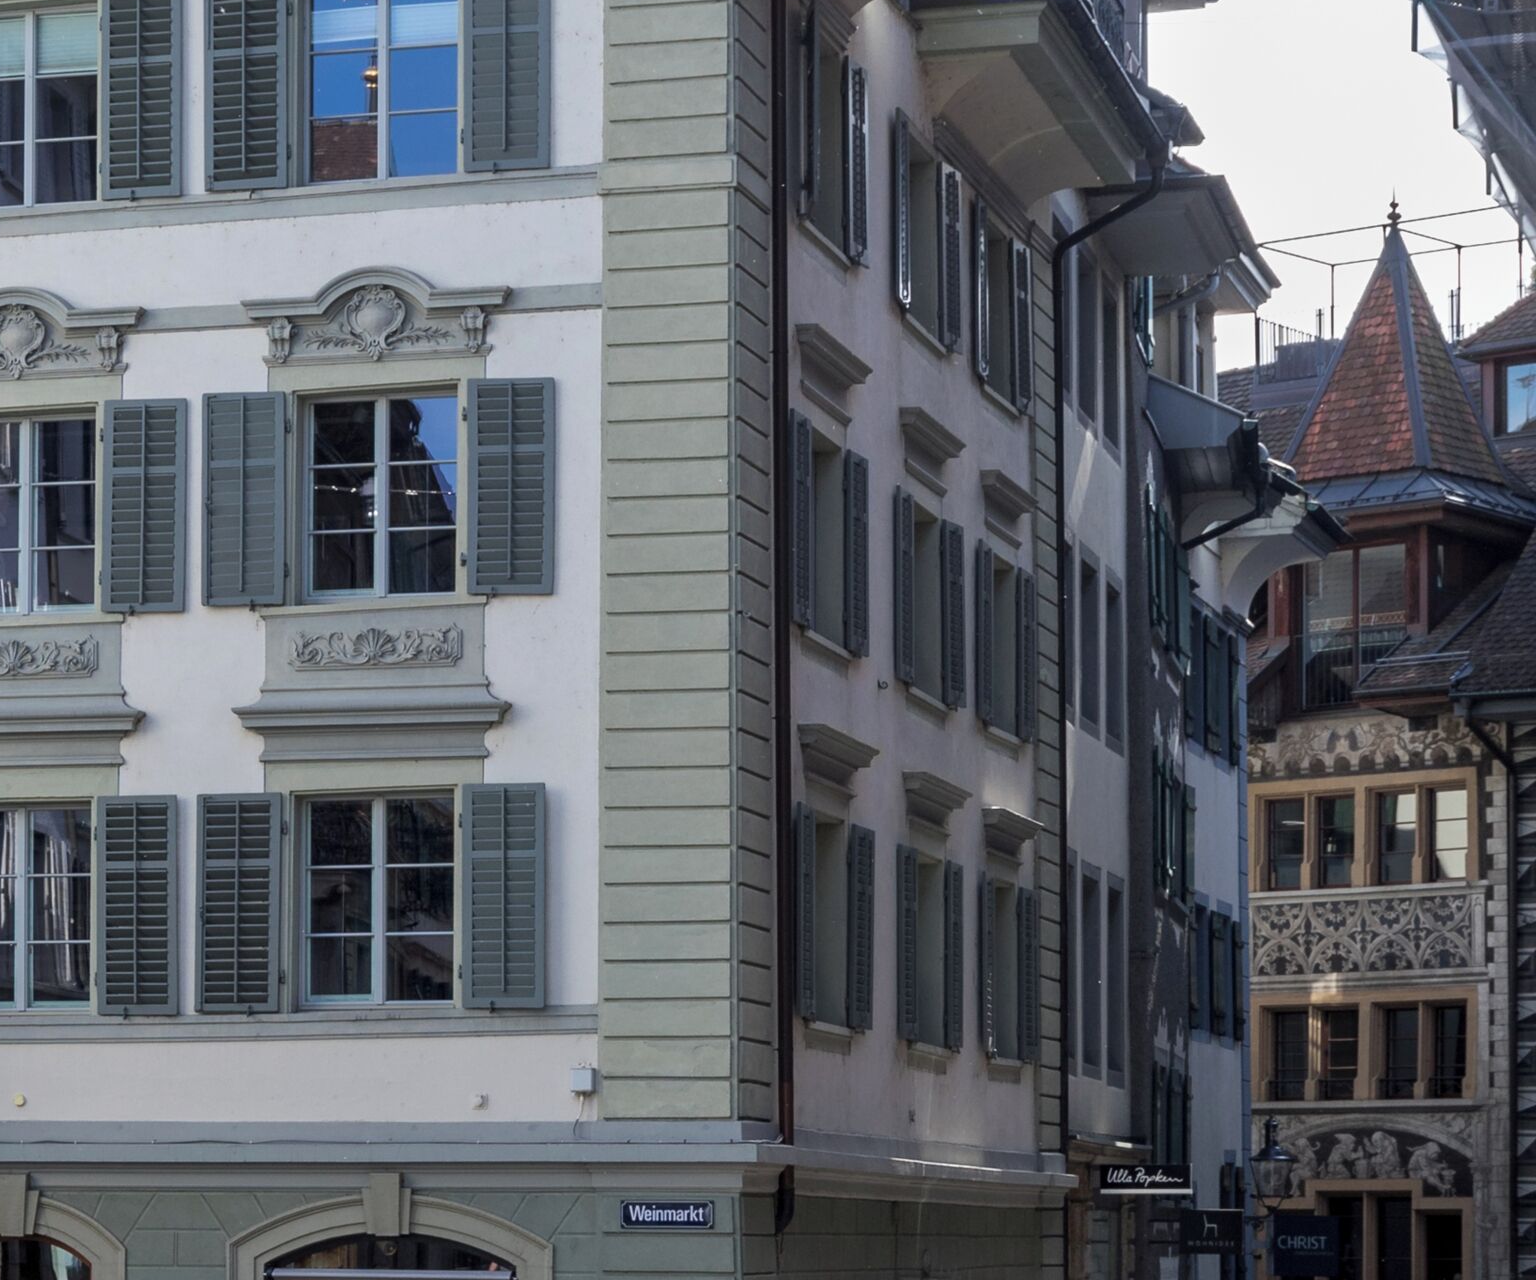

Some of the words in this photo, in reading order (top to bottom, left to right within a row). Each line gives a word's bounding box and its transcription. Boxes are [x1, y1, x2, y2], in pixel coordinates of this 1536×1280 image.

[1107, 1167, 1133, 1183] Ulla
[1134, 1166, 1184, 1188] Popken
[629, 1204, 704, 1222] Weinmarkt
[1277, 1234, 1328, 1250] CHRIST
